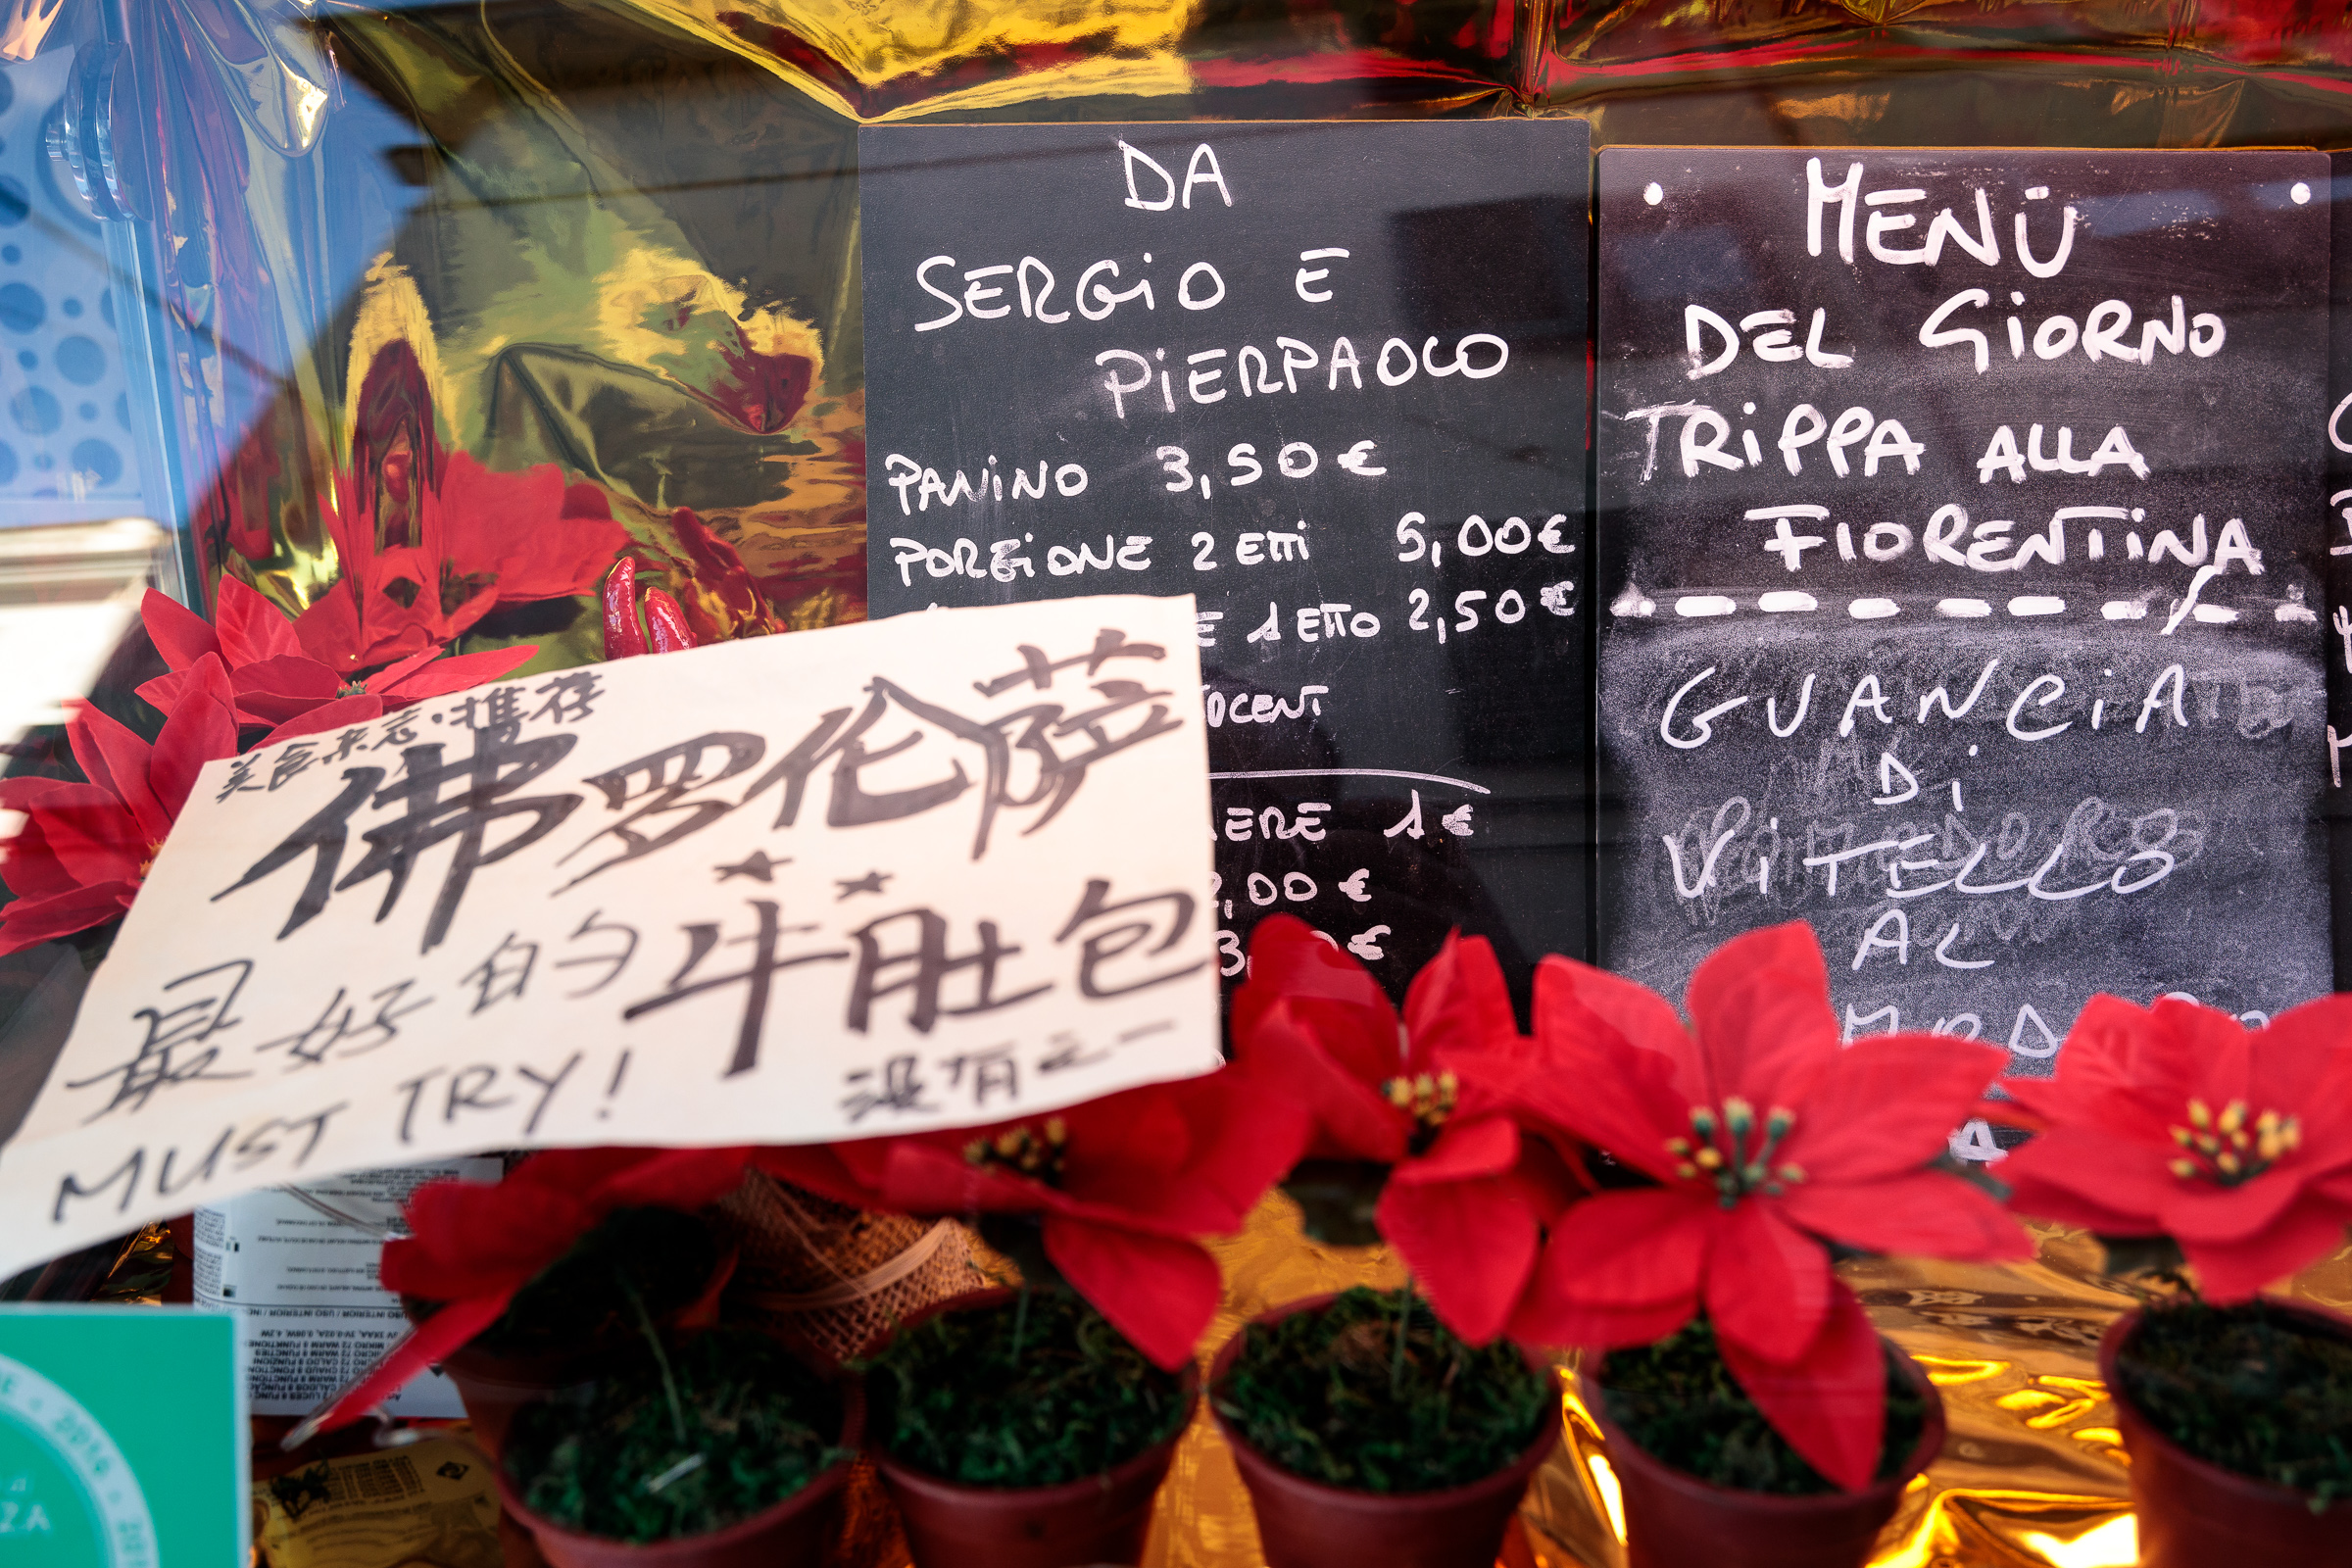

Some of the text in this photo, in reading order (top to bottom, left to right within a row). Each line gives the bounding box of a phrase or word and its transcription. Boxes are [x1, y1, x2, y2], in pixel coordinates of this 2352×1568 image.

[1117, 140, 1233, 212] DA
[1296, 247, 1350, 303] E
[1684, 303, 1855, 381] DEL
[1976, 421, 2153, 485] ALLA
[1192, 532, 1218, 570] 2
[1247, 601, 1282, 644] 1
[1296, 603, 1381, 643] ETTO
[209, 628, 1184, 956] 佛罗伦萨
[1383, 789, 1426, 840] 1
[1851, 907, 1996, 972] AL
[52, 1049, 633, 1222] MUST TRY!
